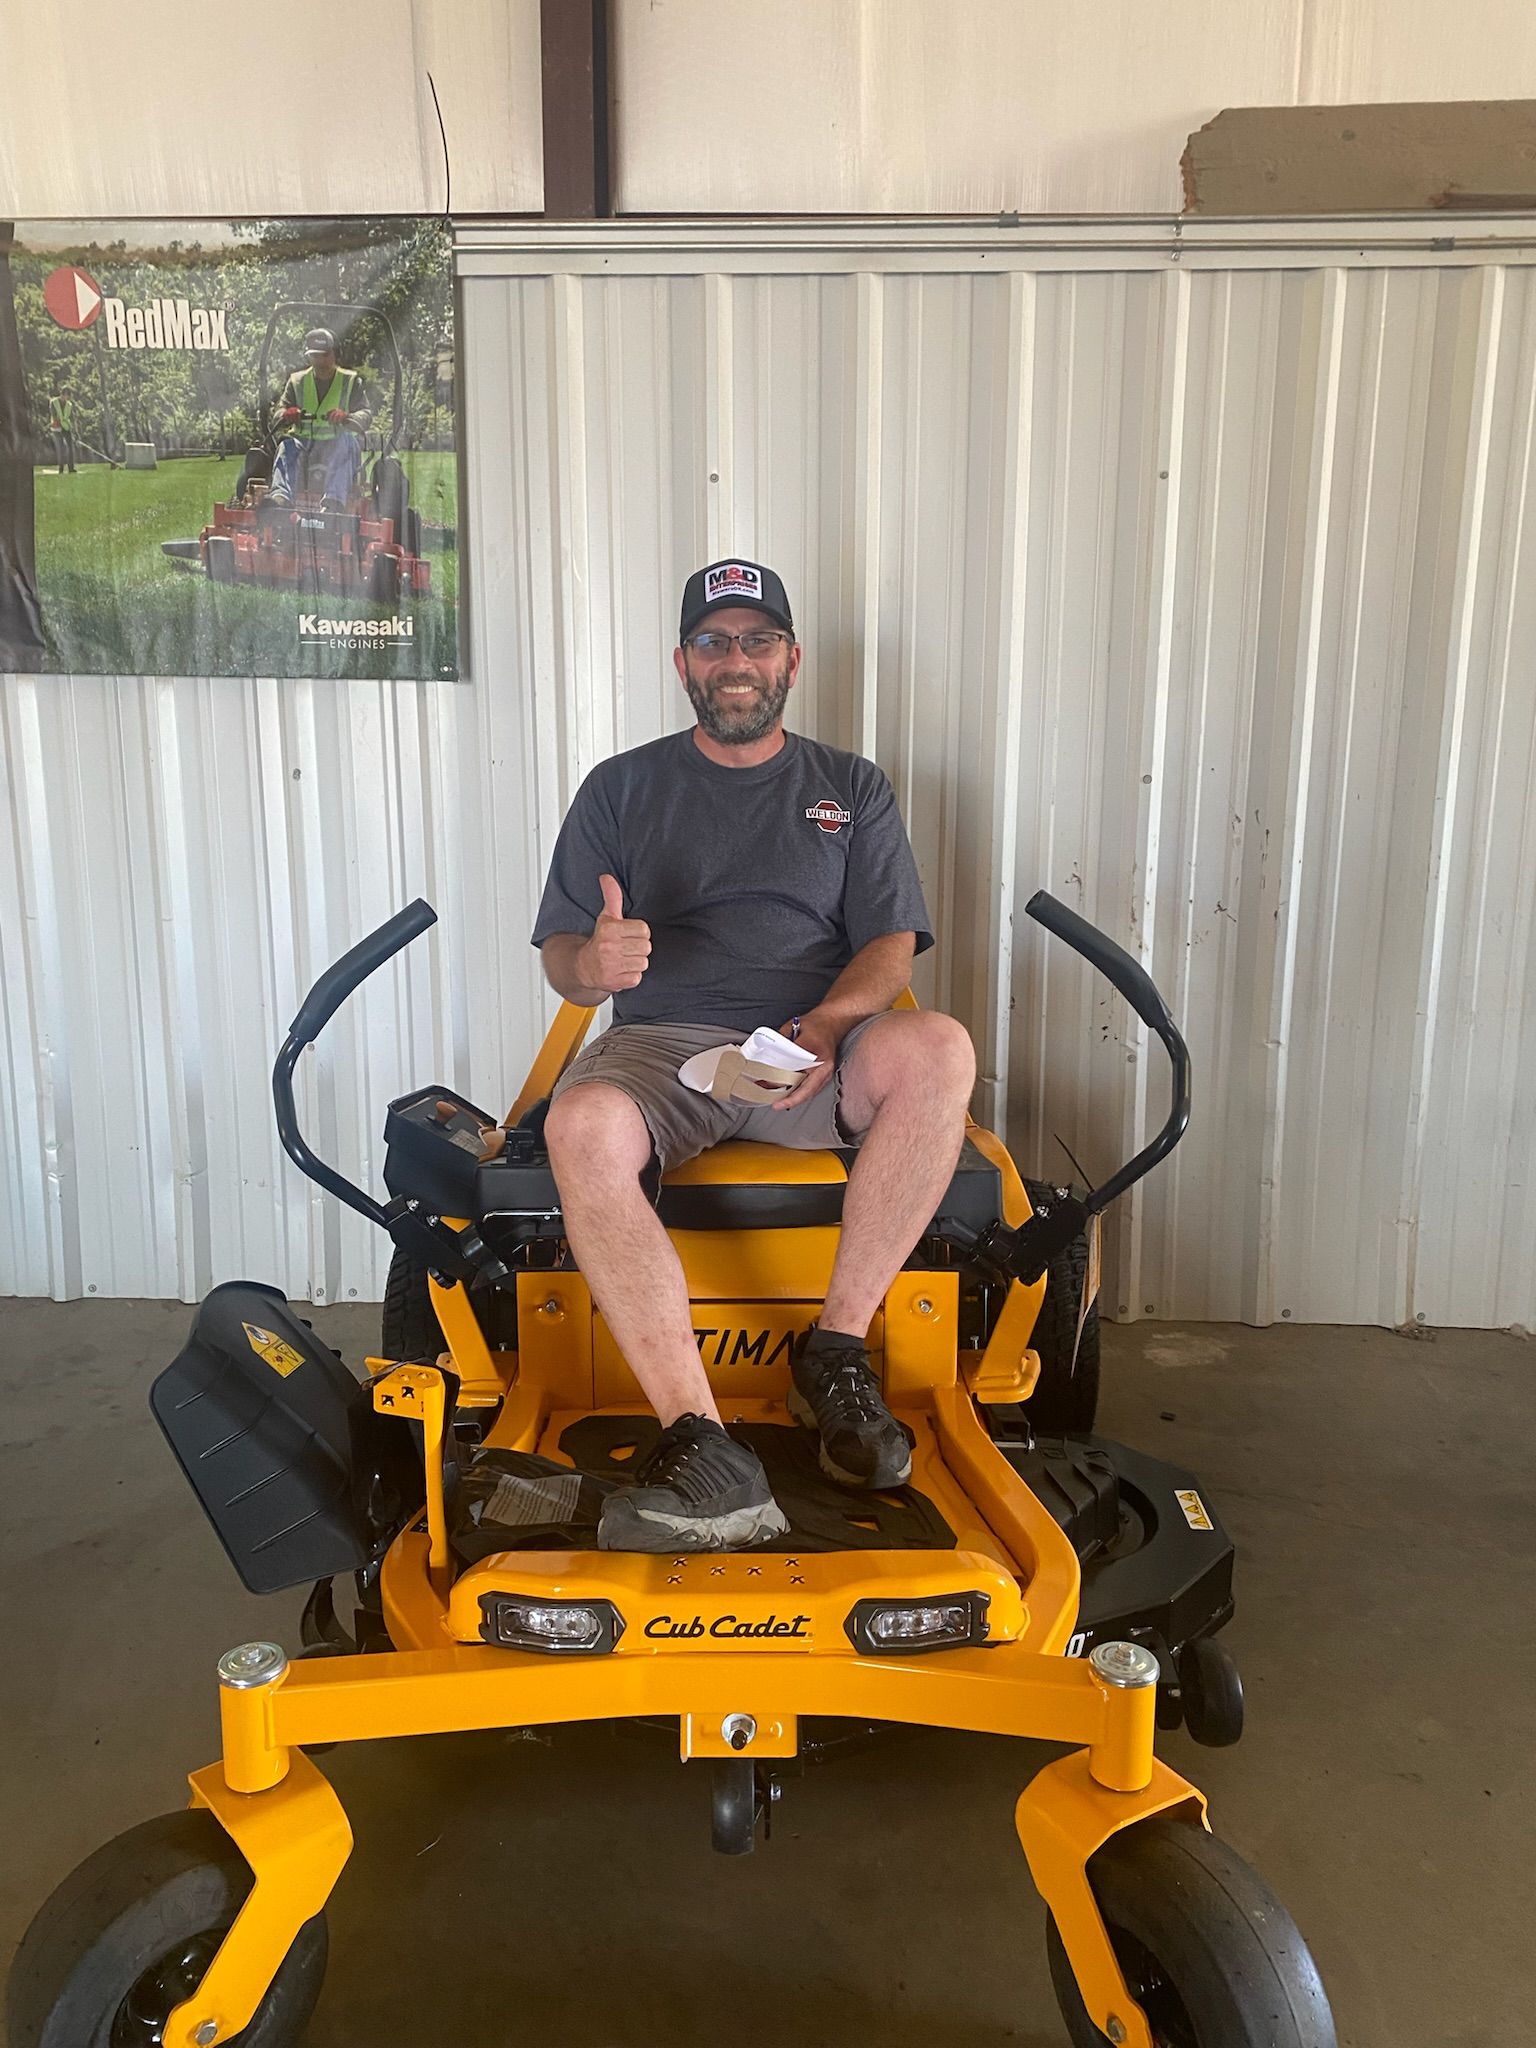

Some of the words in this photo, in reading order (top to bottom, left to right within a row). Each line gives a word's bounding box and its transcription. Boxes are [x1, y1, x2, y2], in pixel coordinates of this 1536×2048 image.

[104, 297, 229, 350] RedMax
[708, 567, 758, 586] M&D
[299, 614, 413, 636] Kawasaki
[329, 639, 385, 650] ENGINES
[807, 809, 849, 821] WELDON
[644, 1615, 705, 1638] Cub
[709, 1615, 811, 1638] Cadet
